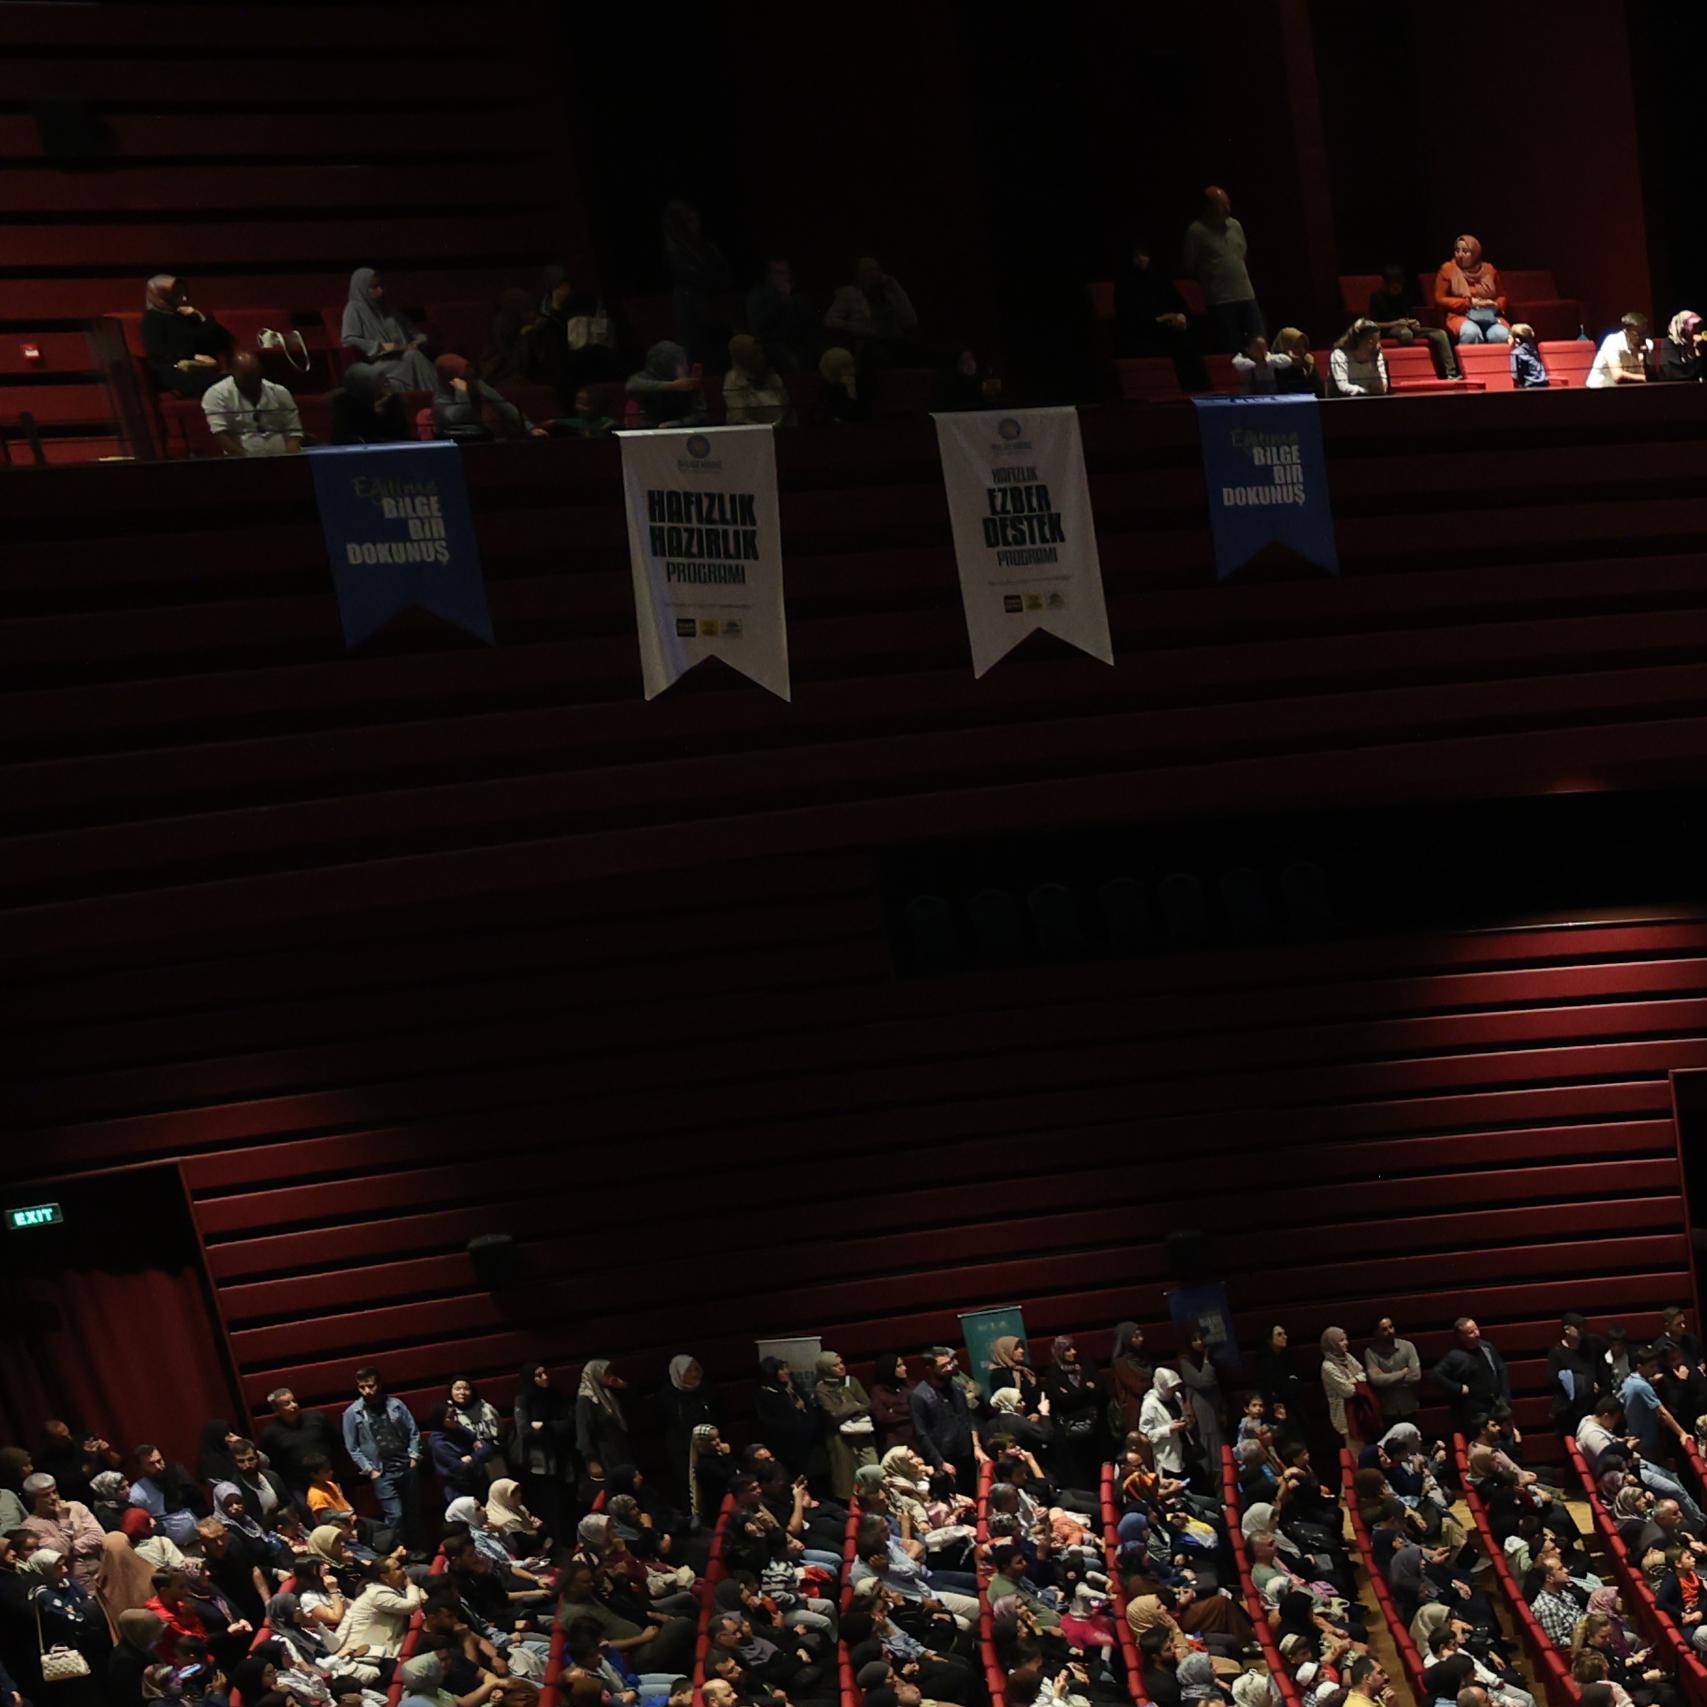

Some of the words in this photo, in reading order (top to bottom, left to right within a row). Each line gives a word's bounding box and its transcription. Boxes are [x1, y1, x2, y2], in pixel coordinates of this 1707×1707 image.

[648, 489, 757, 526] HAFIZLIK
[986, 484, 1052, 517] EZBER
[1222, 484, 1306, 507] DOKUNUŞ
[649, 524, 759, 561] HAZIRLIK
[982, 513, 1066, 549] DESTEK
[346, 540, 450, 566] DOKUNUŞ
[997, 547, 1058, 567] PROGRAMI
[666, 563, 746, 584] PROGRAMI
[14, 1208, 53, 1227] EXIT
